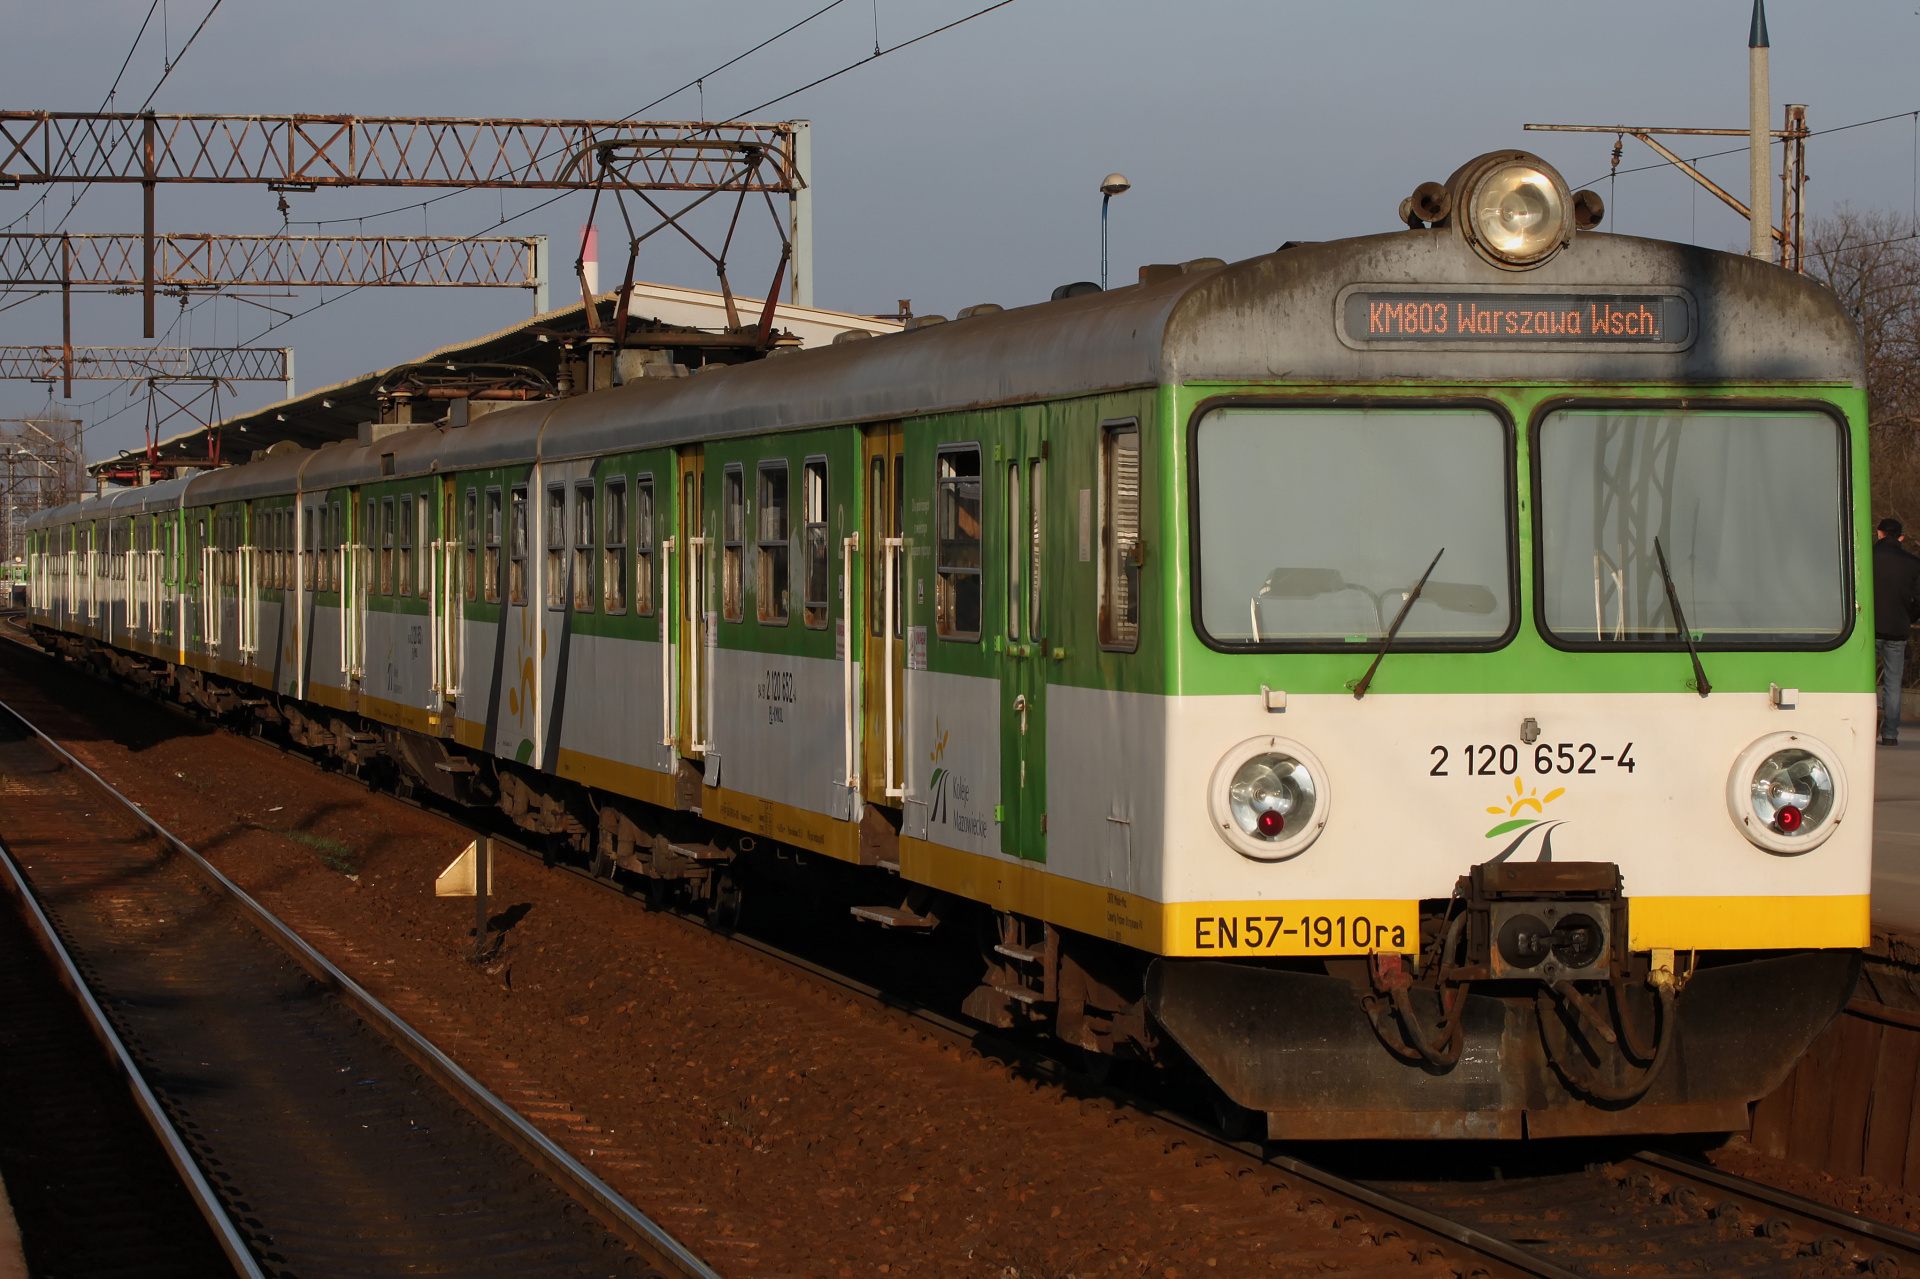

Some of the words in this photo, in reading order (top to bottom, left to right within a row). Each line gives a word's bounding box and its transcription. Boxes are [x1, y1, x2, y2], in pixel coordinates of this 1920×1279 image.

[1369, 302, 1449, 334] KM803
[1457, 303, 1582, 335] Warszawa
[1591, 304, 1660, 335] Wsch.
[710, 509, 717, 559] 2
[838, 503, 844, 560] 2
[766, 670, 771, 700] 2
[771, 671, 781, 701] 120
[1430, 745, 1449, 776] 2
[1464, 744, 1518, 776] 120
[1534, 742, 1635, 775] 652-4
[953, 776, 970, 809] Koleje
[953, 808, 988, 839] Mazowieckie
[1195, 916, 1405, 949] EN57-1910ra
